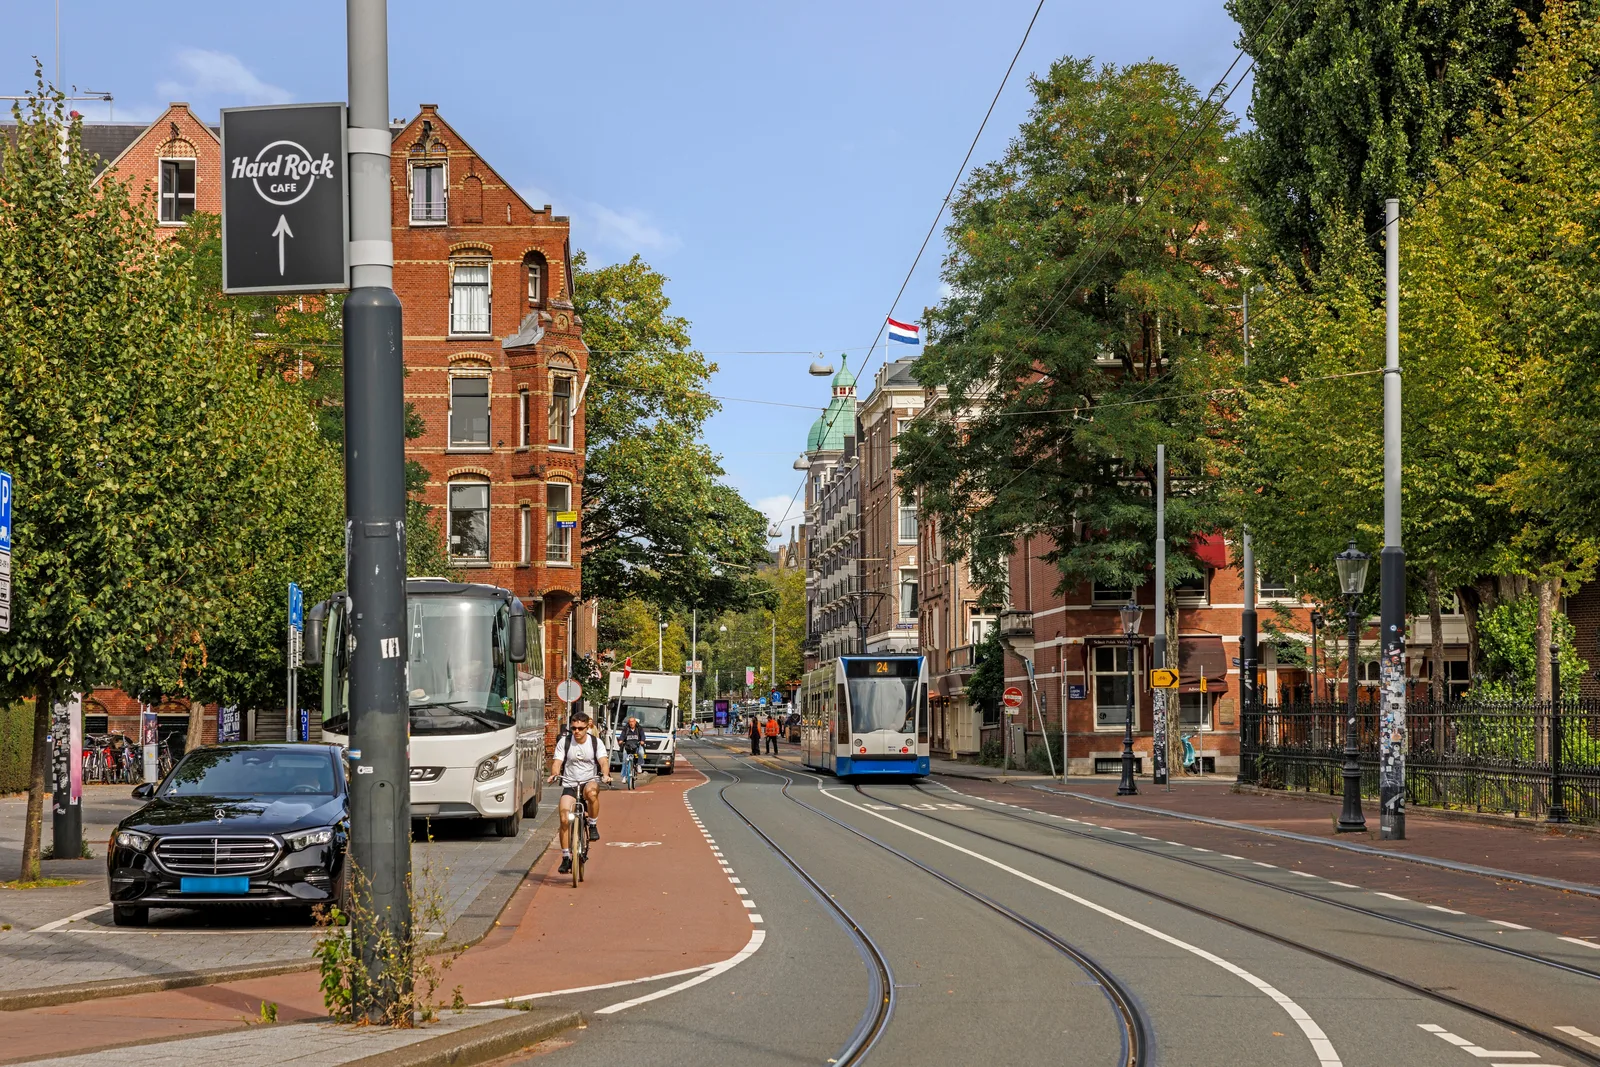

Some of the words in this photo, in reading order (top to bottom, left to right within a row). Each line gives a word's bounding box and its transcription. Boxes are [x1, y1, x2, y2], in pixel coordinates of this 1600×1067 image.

[231, 154, 283, 179] Hard
[283, 152, 335, 181] Rock
[270, 183, 297, 193] CAFE
[1, 479, 9, 517] P
[876, 661, 888, 673] 24
[409, 768, 435, 779] DL
